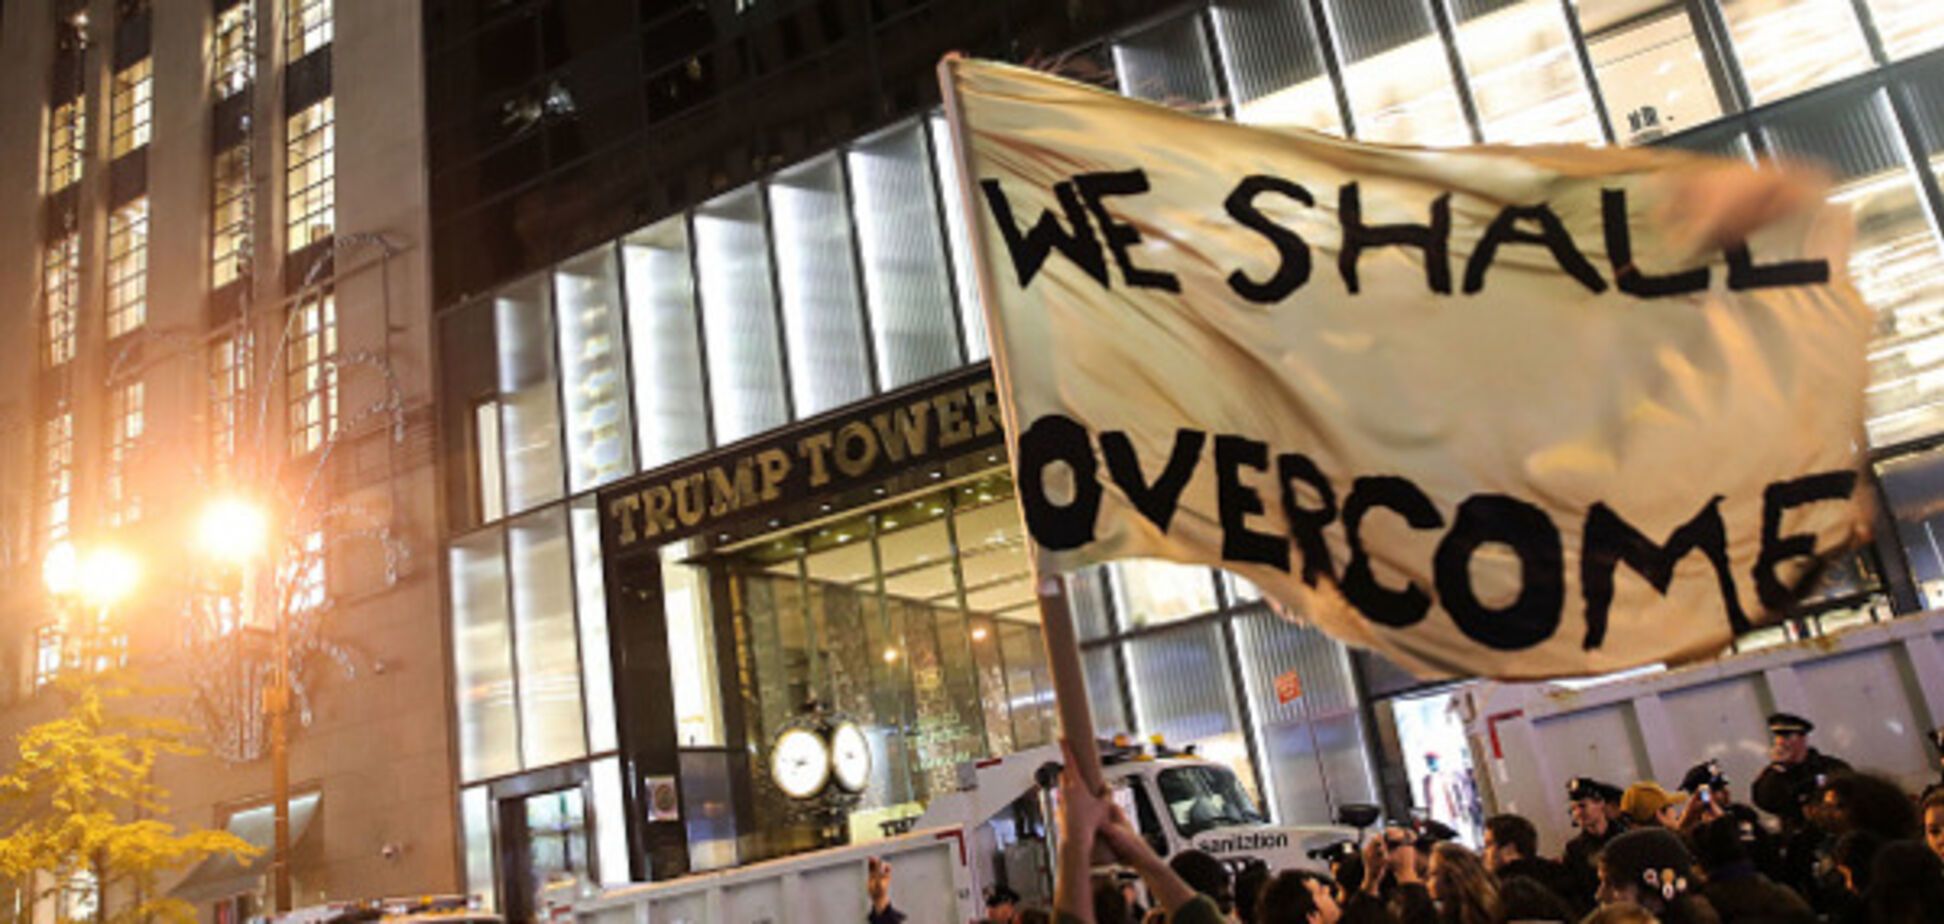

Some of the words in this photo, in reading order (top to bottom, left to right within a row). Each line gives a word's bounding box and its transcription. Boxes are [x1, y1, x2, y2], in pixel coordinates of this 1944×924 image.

[980, 168, 1181, 294] WE
[1224, 174, 1830, 304] SHALL
[610, 449, 791, 546] TRUMP
[797, 381, 1002, 487] TOWER
[1018, 414, 1858, 651] OVERCOME
[1199, 831, 1288, 854] sanitation
